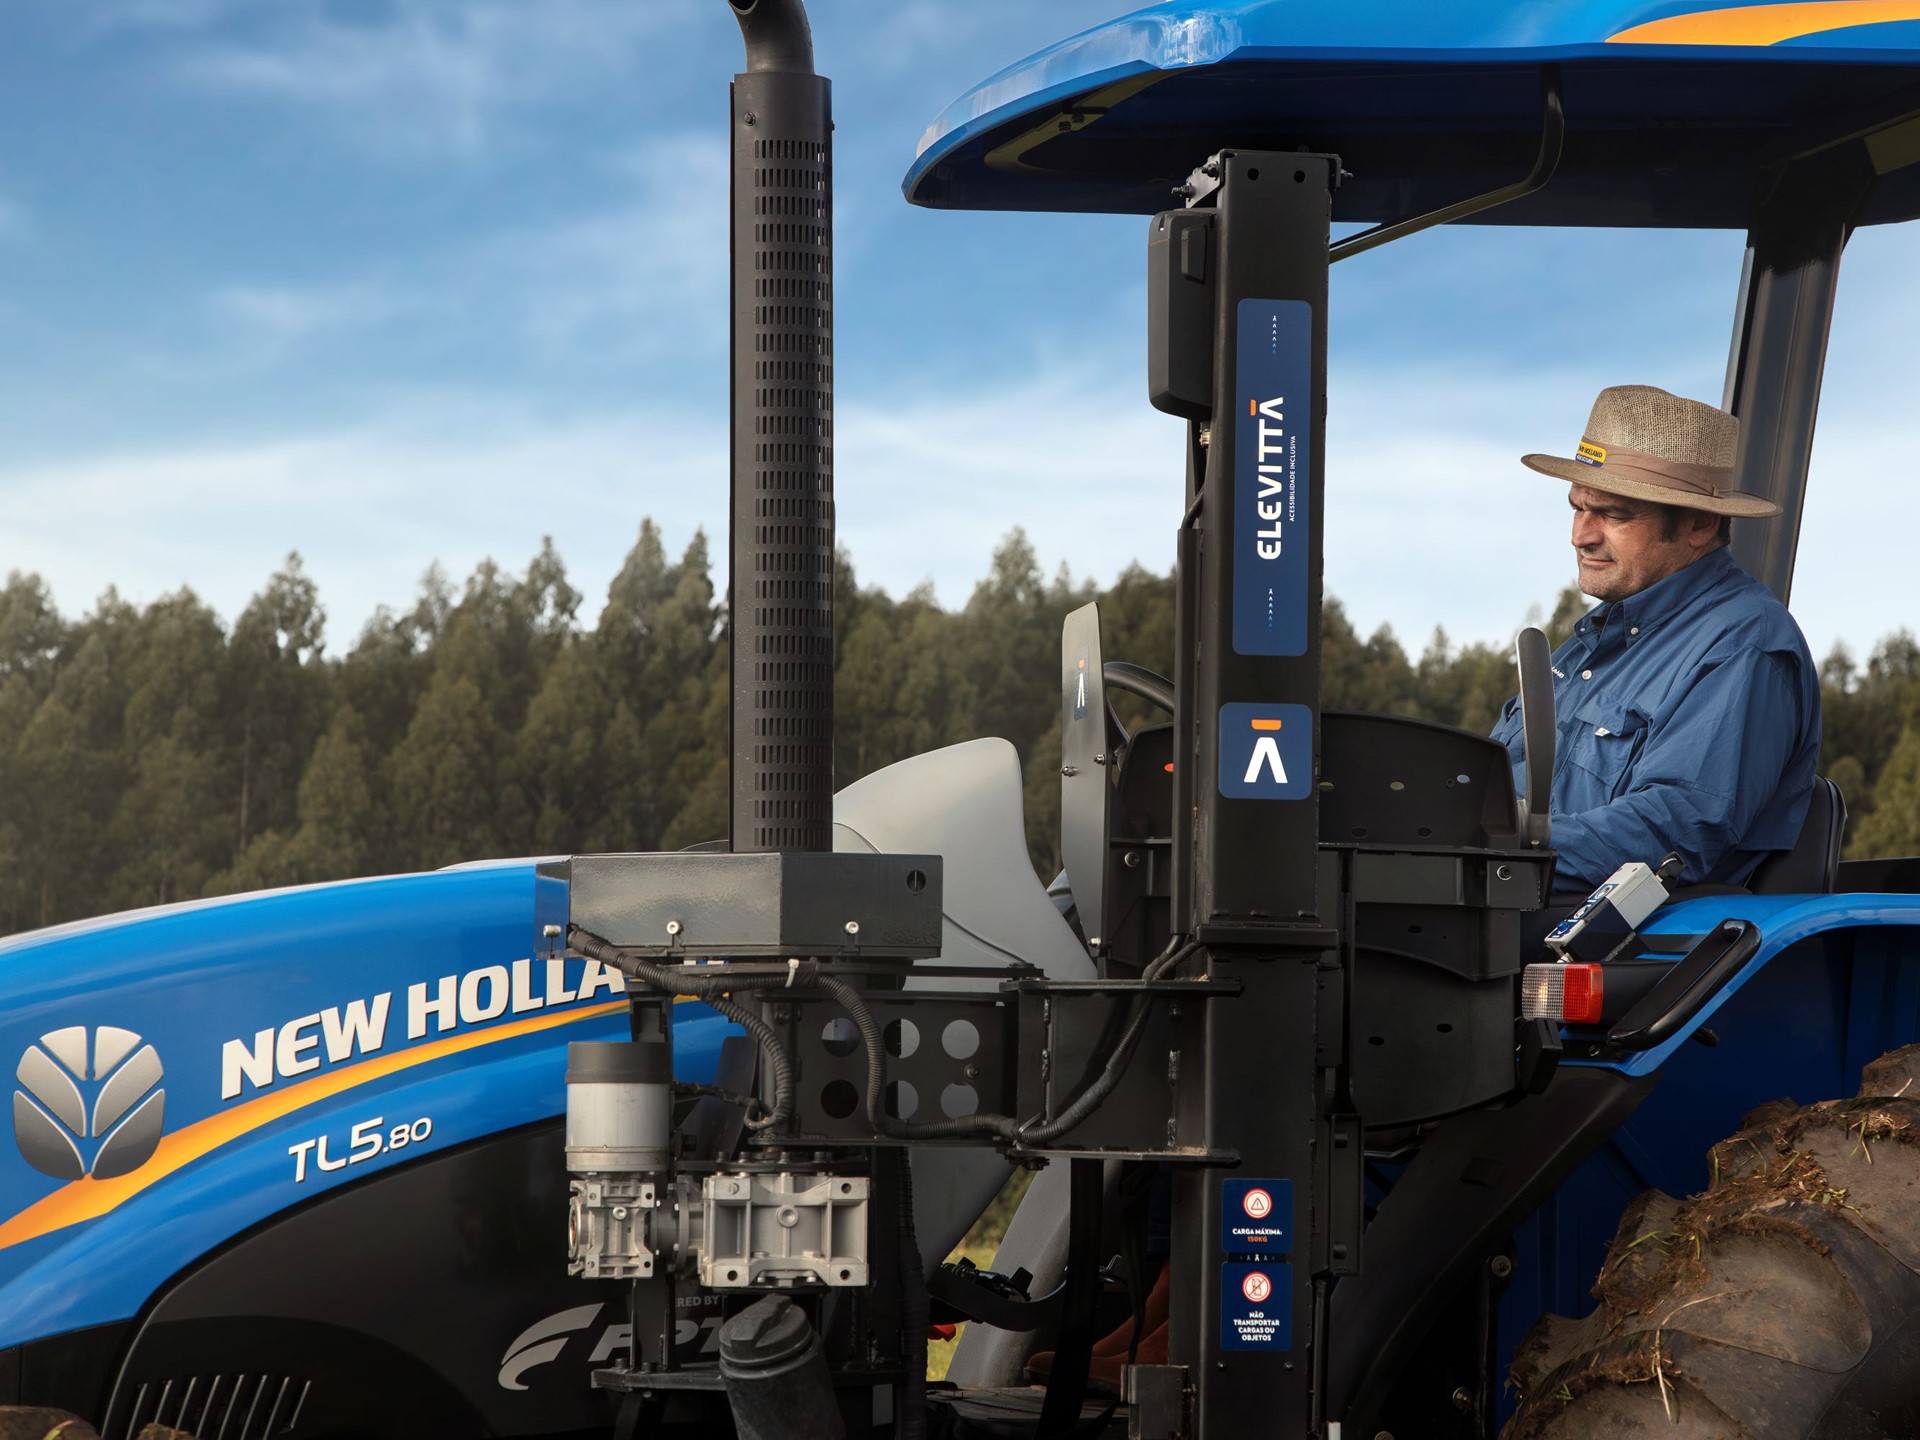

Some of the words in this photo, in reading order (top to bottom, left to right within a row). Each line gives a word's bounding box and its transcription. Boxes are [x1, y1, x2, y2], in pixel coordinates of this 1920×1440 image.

[1289, 435, 1297, 470] INCLUSIVA
[1288, 470, 1296, 522] ACESSIBILIDADE
[222, 991, 391, 1100] NEW
[288, 1116, 432, 1183] TL5.80
[1232, 1227, 1254, 1235] CARGA
[1255, 1227, 1282, 1235] MÁXIMA:
[704, 1295, 720, 1306] BY
[1249, 1310, 1264, 1318] NÃO
